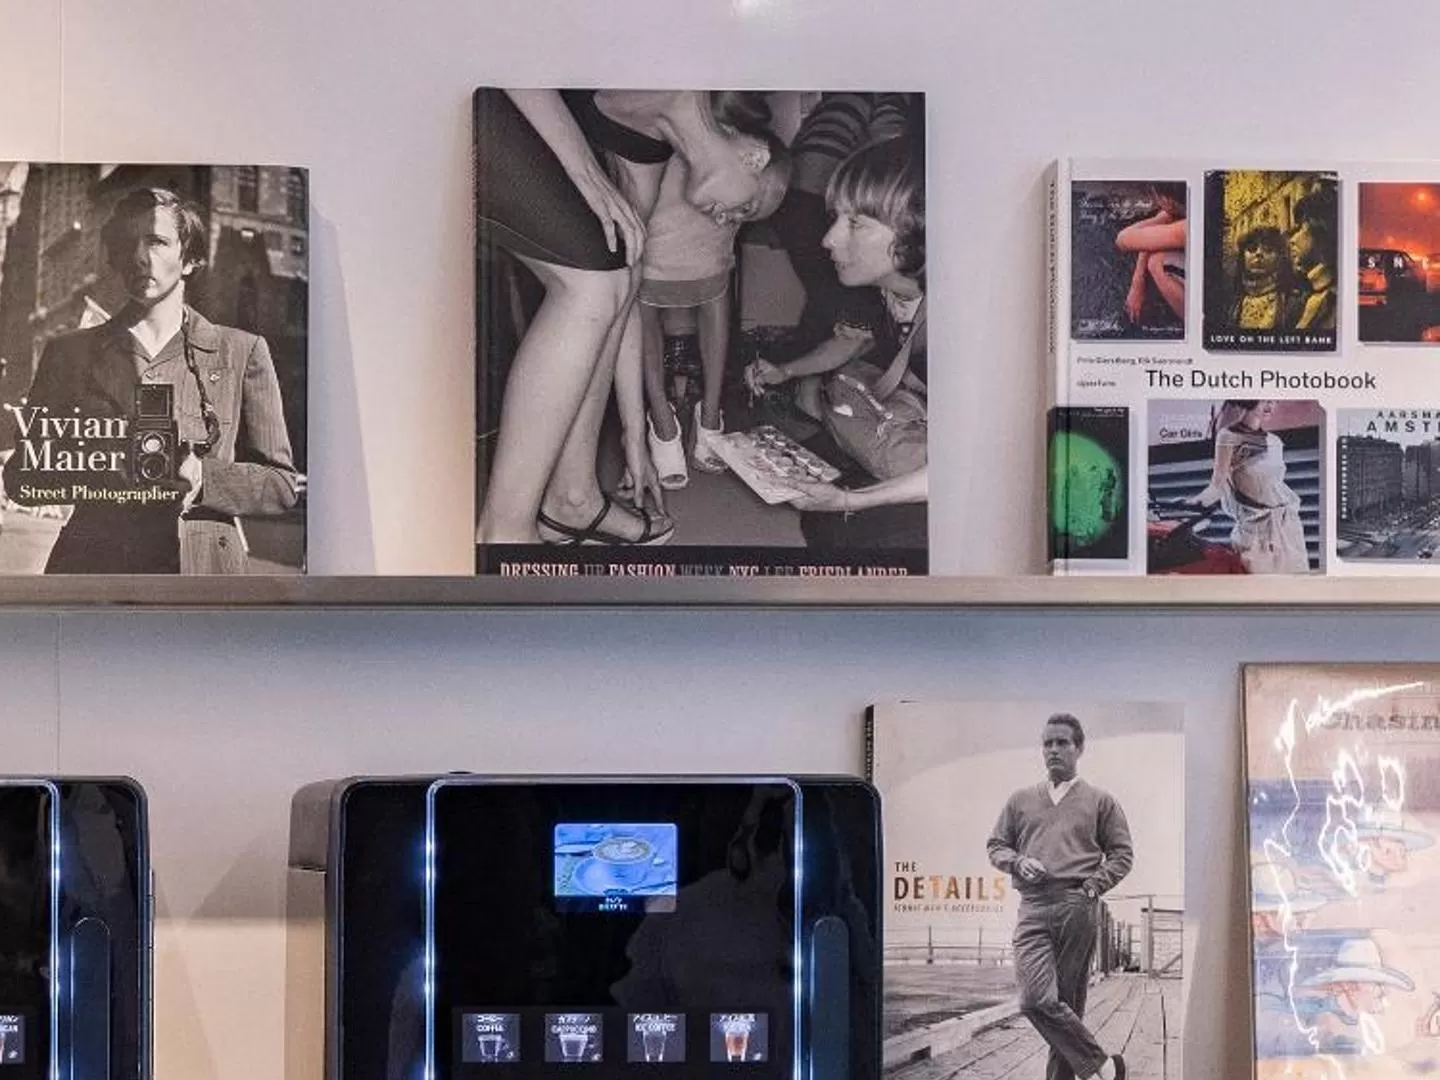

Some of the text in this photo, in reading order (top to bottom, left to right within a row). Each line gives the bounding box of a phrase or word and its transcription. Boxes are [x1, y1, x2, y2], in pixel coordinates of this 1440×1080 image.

[1210, 334, 1235, 343] LOVE
[1145, 369, 1377, 390] The Dutch Photobook
[11, 405, 128, 440] Vivian
[1366, 420, 1440, 434] AMST
[20, 440, 126, 472] Maier
[19, 484, 180, 506] Street Photographer
[894, 861, 917, 873] THE
[894, 875, 1006, 901] DETAILS
